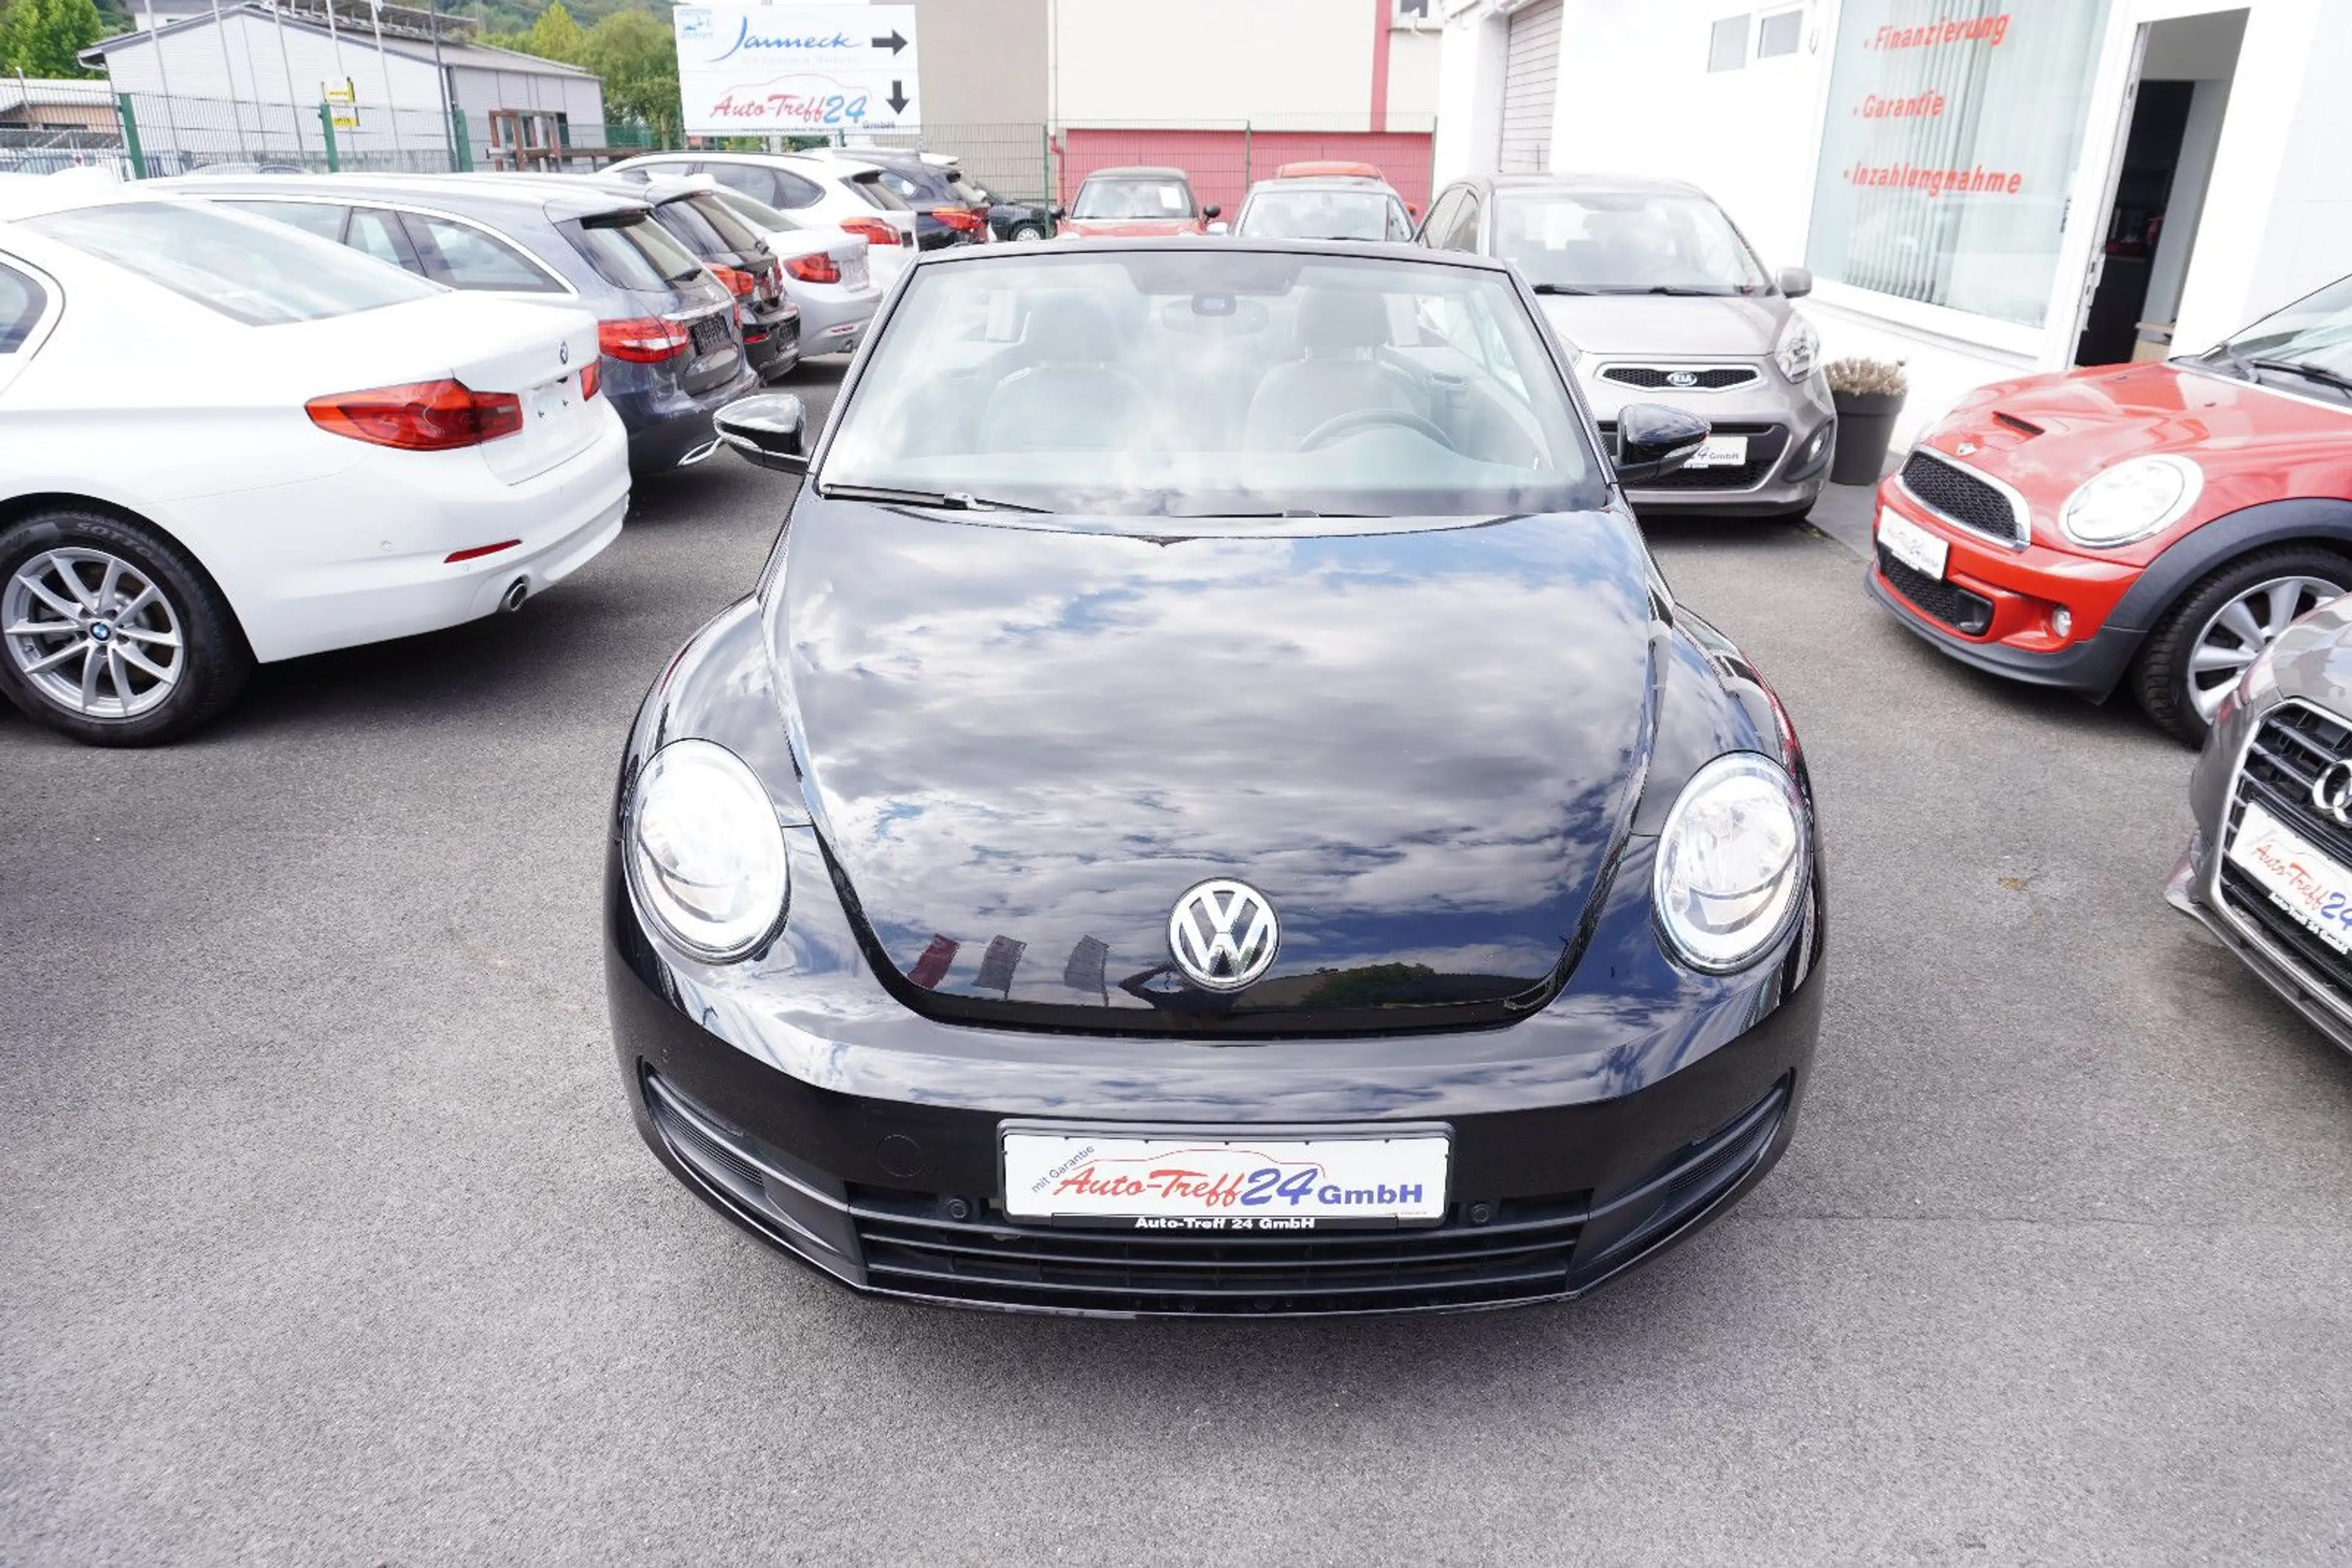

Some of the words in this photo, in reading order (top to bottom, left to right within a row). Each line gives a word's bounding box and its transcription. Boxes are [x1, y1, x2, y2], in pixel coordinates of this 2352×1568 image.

[1874, 15, 2009, 50] Finanzierung
[1863, 89, 1945, 118] Garantie
[1853, 162, 2022, 196] Inzahlungnahme
[1673, 374, 1696, 383] KIA
[1031, 1176, 1051, 1193] mit
[1049, 1145, 1095, 1178] Garantie
[1318, 1184, 1423, 1205] GmbH
[1134, 1216, 1226, 1229] Auto-Treff
[1231, 1218, 1253, 1229] 24
[1259, 1217, 1316, 1229] GmbH
